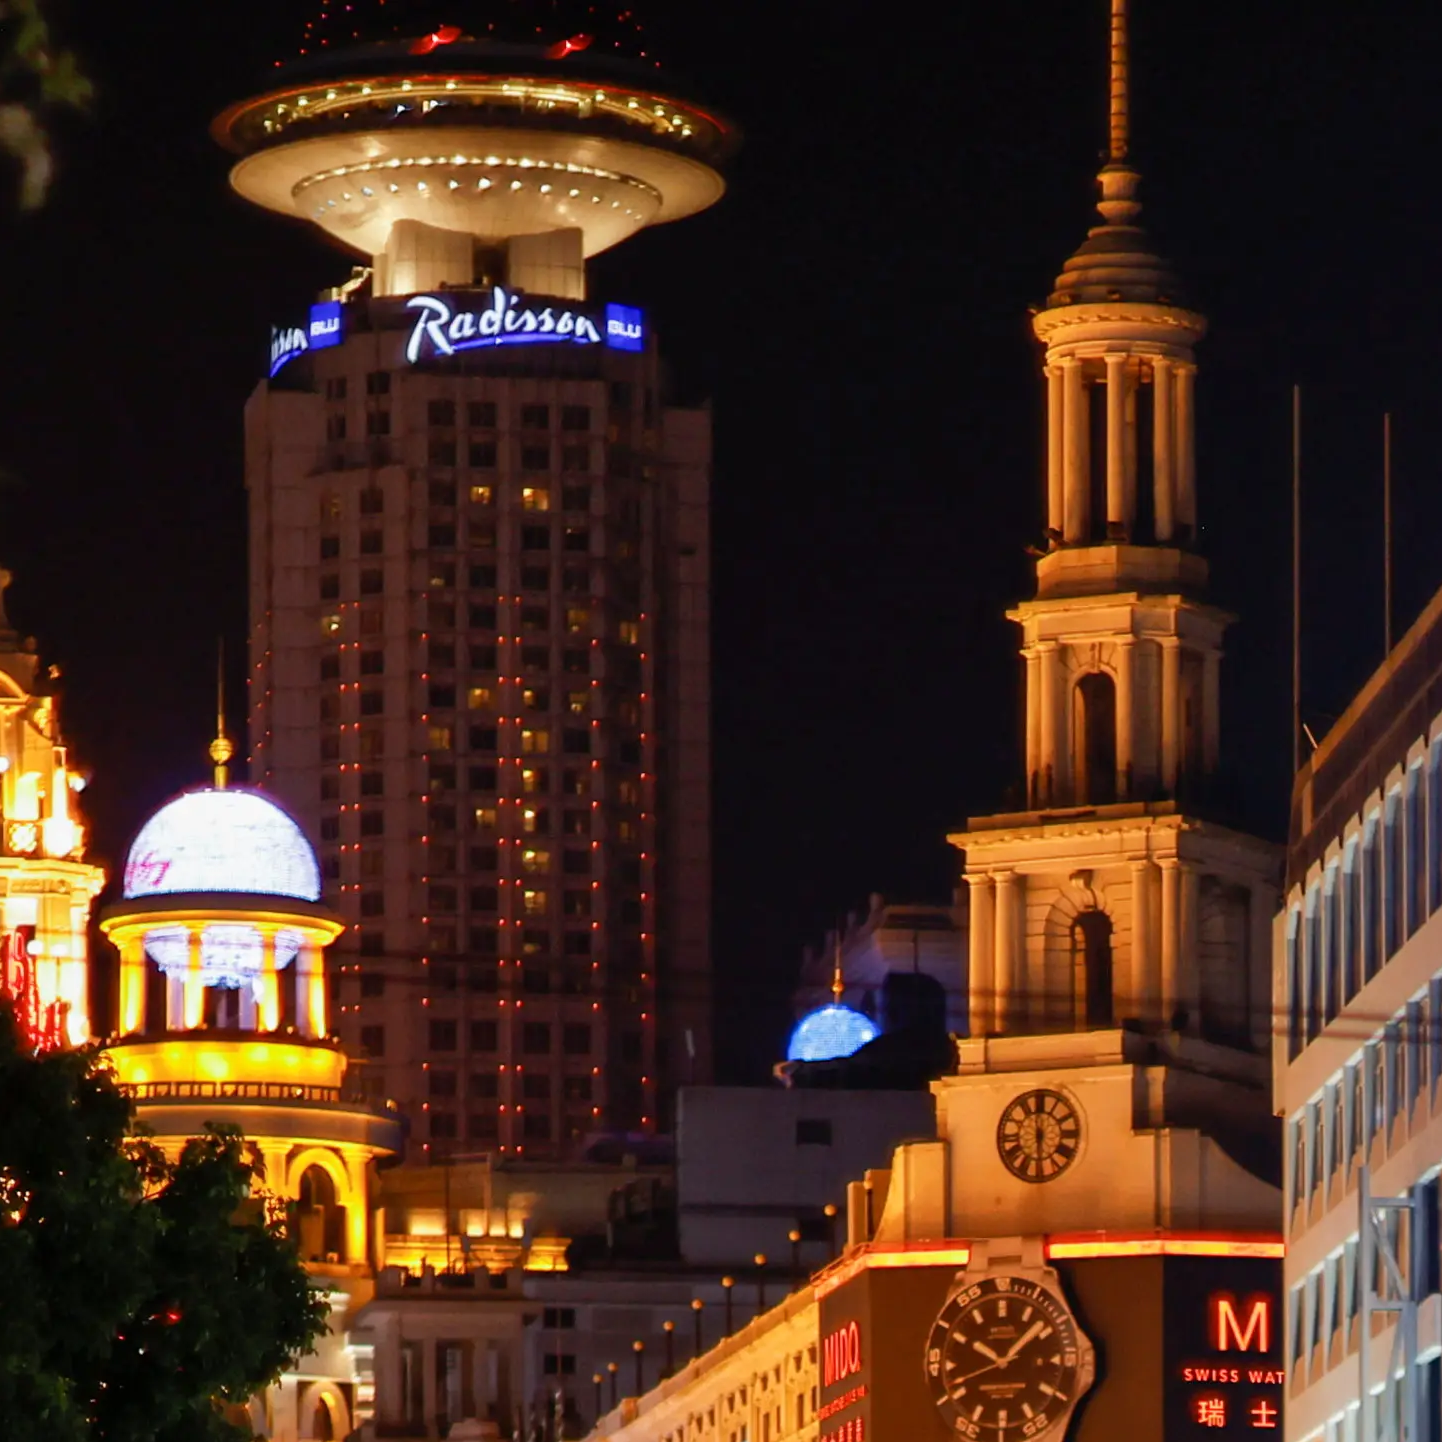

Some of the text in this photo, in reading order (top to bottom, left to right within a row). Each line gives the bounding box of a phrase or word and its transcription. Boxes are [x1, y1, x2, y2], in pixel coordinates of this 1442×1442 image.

[406, 287, 642, 363] Radisson BLU
[1183, 1368, 1239, 1383] SWISS
